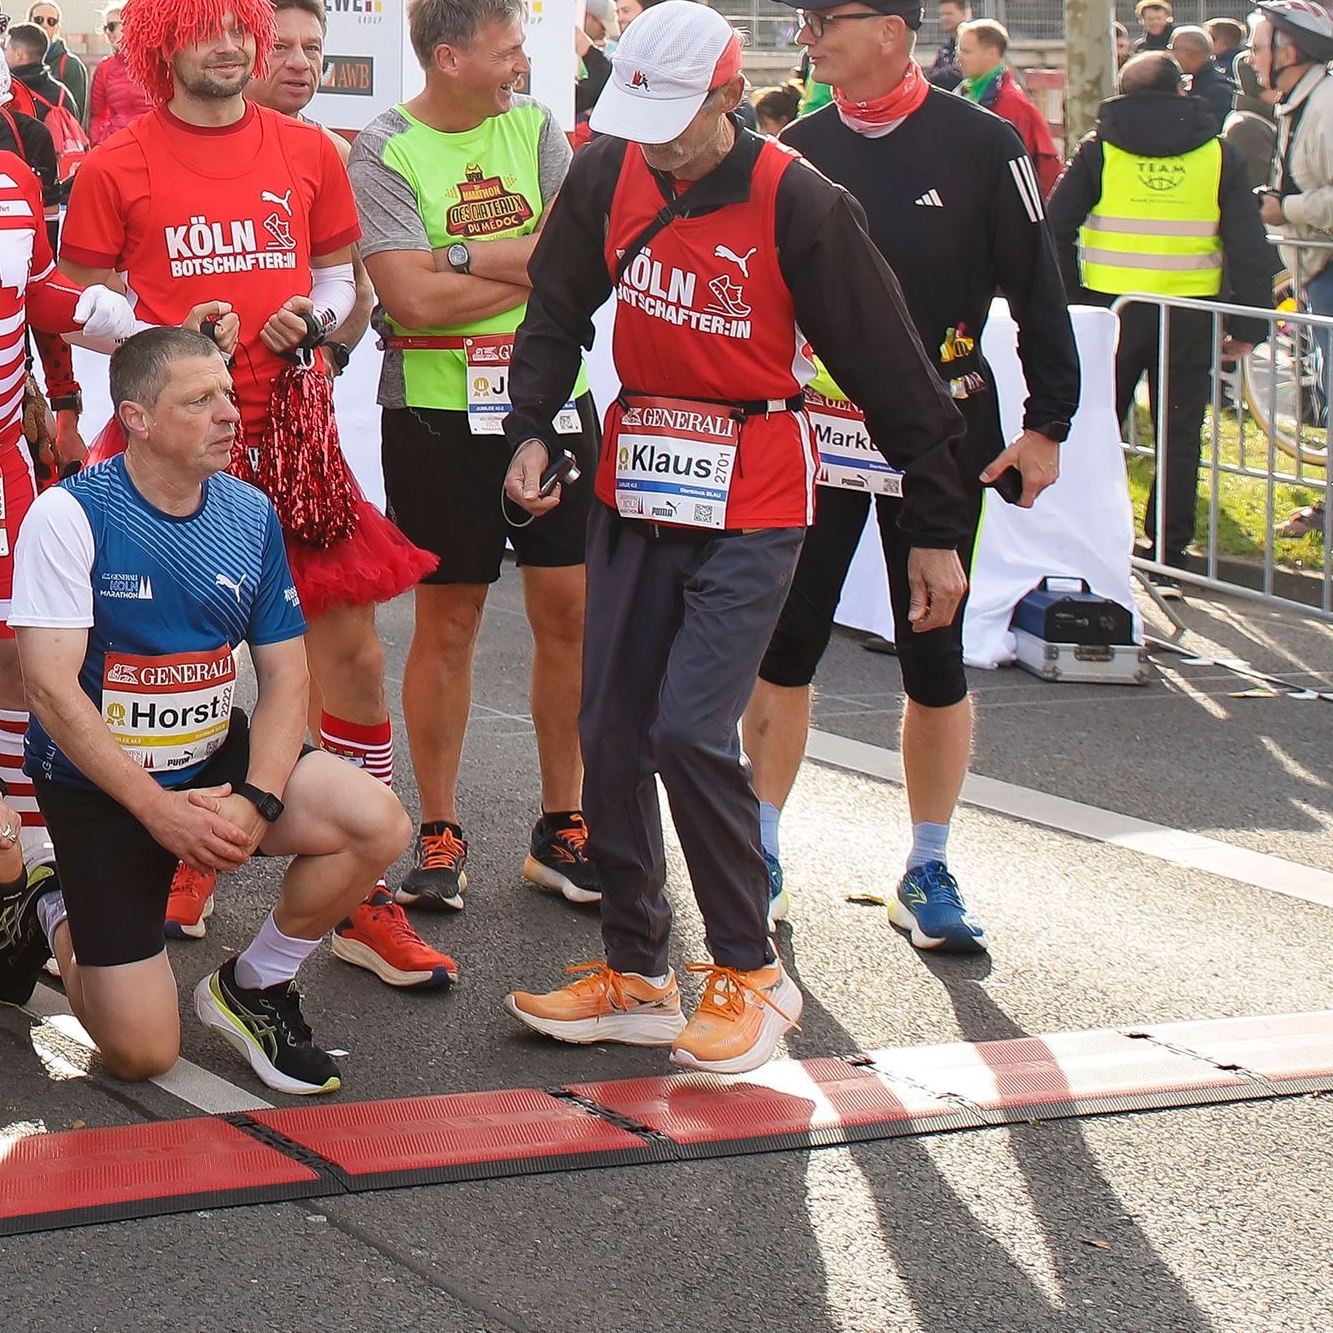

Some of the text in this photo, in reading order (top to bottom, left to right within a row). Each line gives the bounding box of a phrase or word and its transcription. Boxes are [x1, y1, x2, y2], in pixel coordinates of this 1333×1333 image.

[336, 62, 369, 89] AWB
[450, 204, 471, 225] DES
[467, 223, 481, 234] DU
[165, 216, 257, 259] KÖLN
[171, 252, 296, 278] BOTSCHAFTER:IN
[643, 407, 736, 438] GENERALI
[631, 443, 713, 479] Klaus
[714, 451, 731, 485] 2701
[651, 507, 674, 517] PUMA
[110, 573, 138, 581] GENERALI
[99, 589, 139, 599] MARATHON
[140, 656, 233, 686] GENERALI
[130, 695, 221, 729] Horst
[220, 685, 233, 718] 2222
